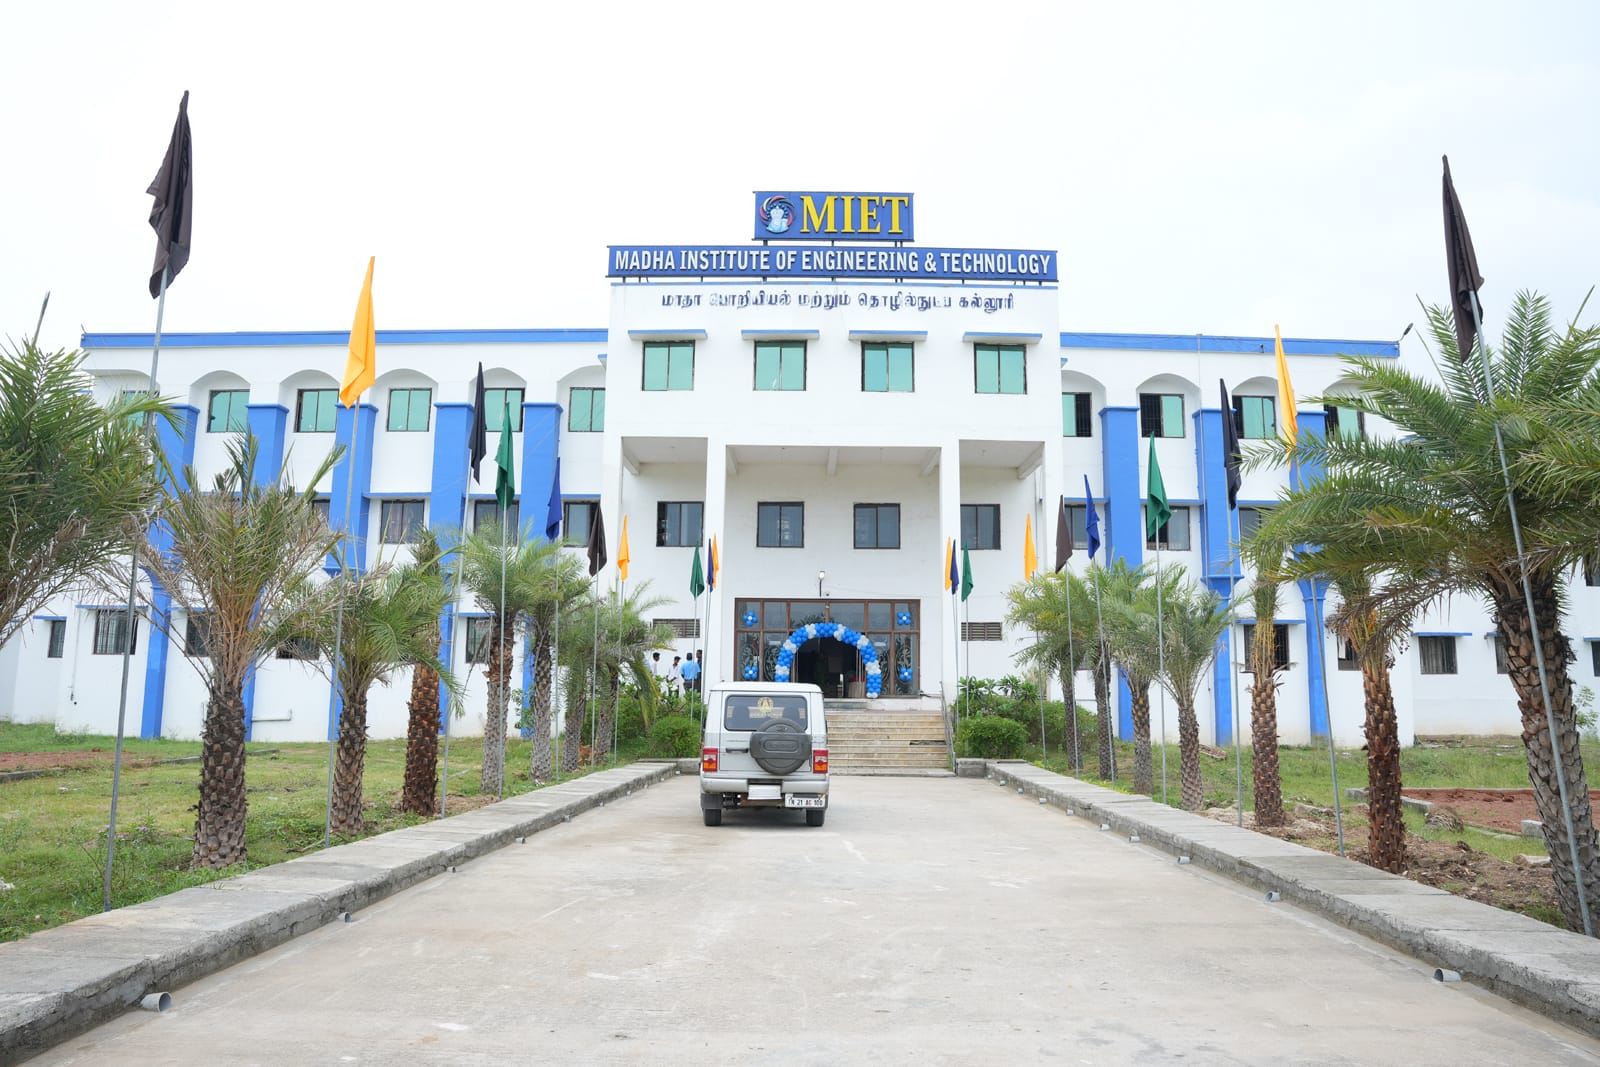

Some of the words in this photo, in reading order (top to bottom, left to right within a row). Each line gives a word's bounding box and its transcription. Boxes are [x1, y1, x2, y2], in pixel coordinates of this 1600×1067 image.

[800, 195, 909, 235] MIET
[615, 249, 675, 271] MADHA
[679, 250, 770, 271] INSTITUTE
[776, 250, 797, 271] OF
[801, 250, 919, 272] ENGINEERING
[924, 252, 937, 273] &
[940, 253, 1051, 275] TECHNOLOGY
